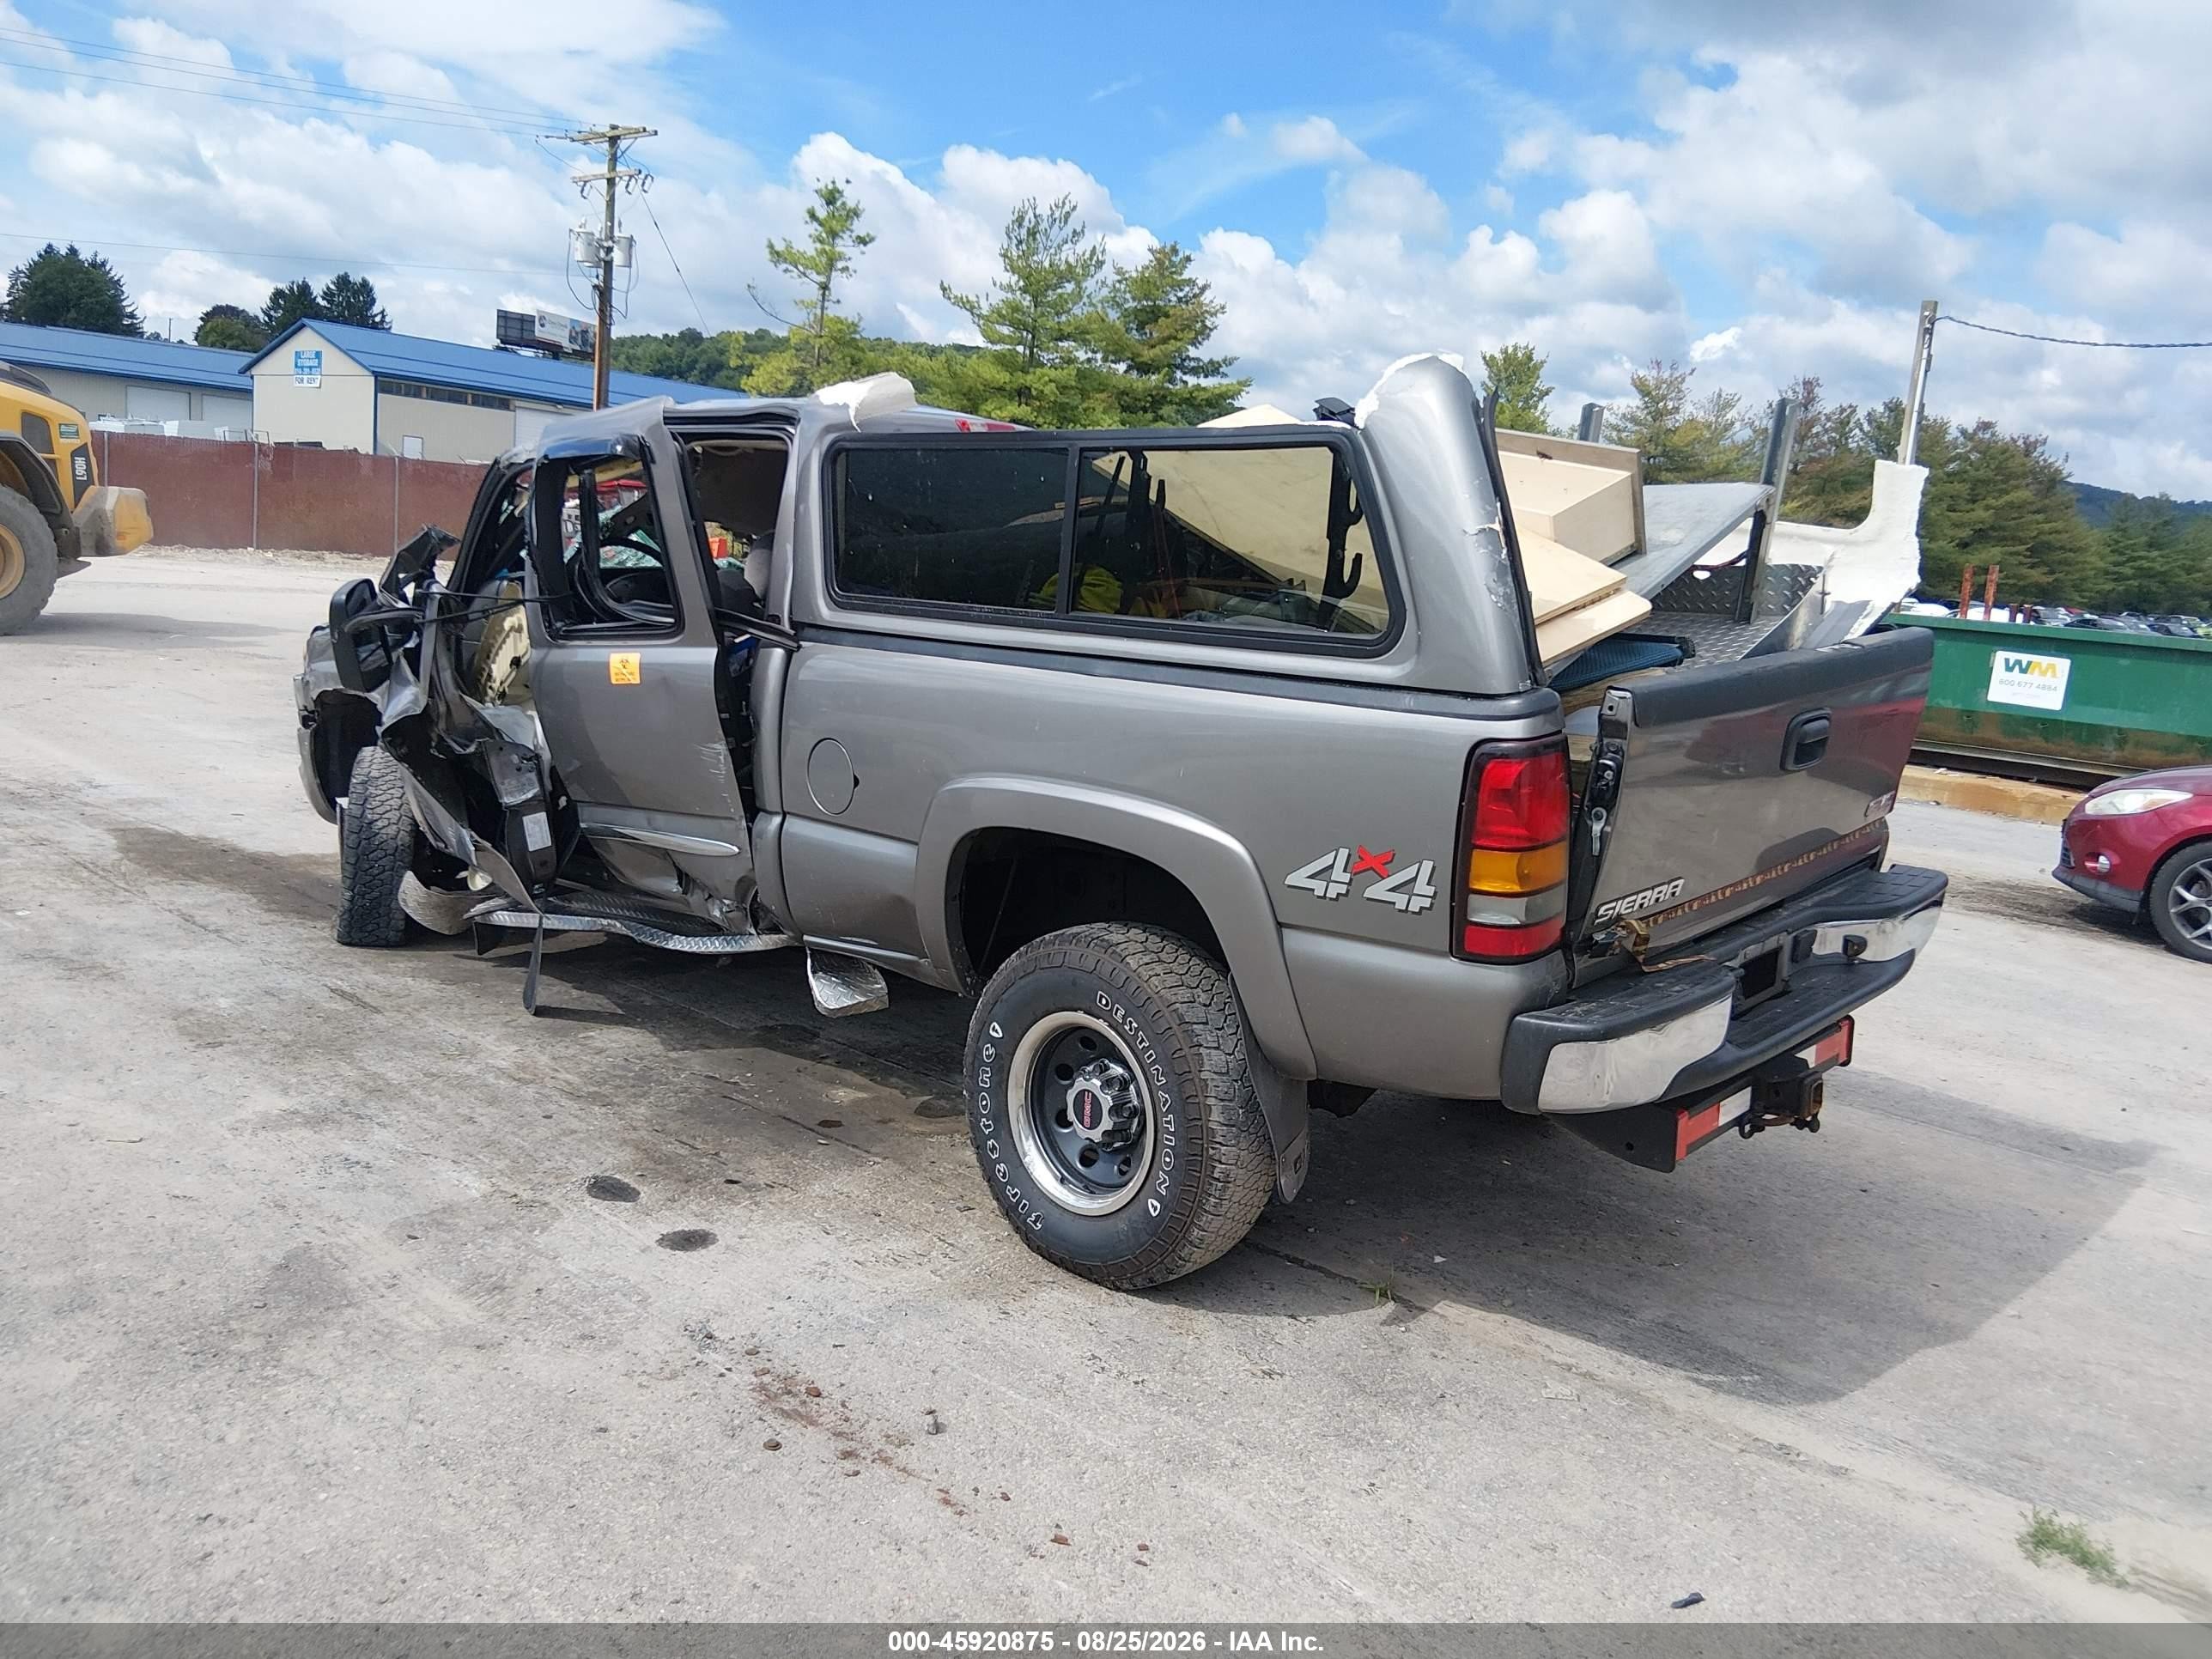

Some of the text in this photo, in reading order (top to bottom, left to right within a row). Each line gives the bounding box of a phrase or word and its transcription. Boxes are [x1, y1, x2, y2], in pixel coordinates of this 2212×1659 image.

[297, 358, 319, 367] STORAGE
[301, 350, 316, 359] LARGE
[295, 376, 319, 385] FOR RENT
[74, 456, 88, 481] L90H
[2003, 658, 2058, 678] WM
[1594, 878, 1685, 926] SIERRA
[1096, 990, 1176, 1196] DESTINATION
[1082, 1091, 1093, 1128] GMC
[977, 1042, 1045, 1231] Firestone
